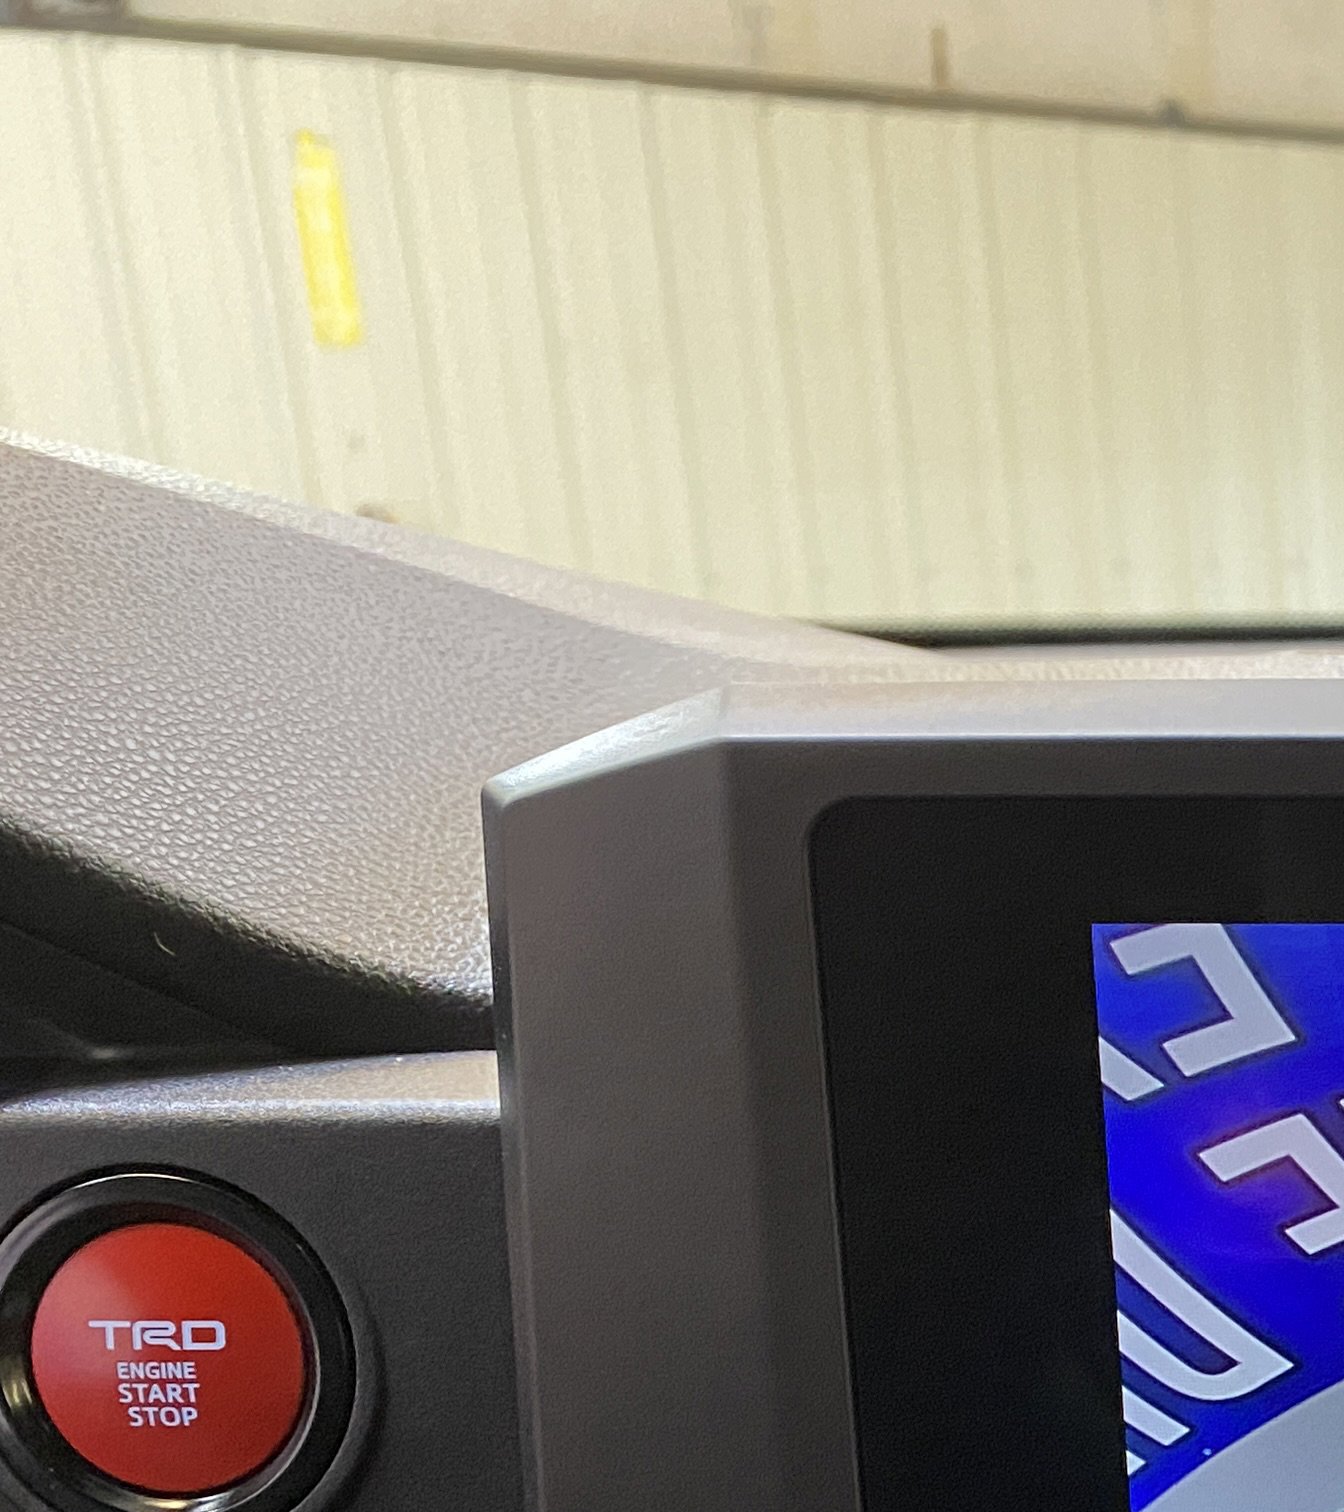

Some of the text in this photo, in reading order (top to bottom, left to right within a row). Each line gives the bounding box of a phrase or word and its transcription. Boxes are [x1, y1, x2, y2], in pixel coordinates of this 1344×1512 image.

[87, 1319, 227, 1351] TRD
[116, 1361, 197, 1380] ENGINE
[117, 1382, 200, 1404] START
[128, 1406, 199, 1428] STOP
